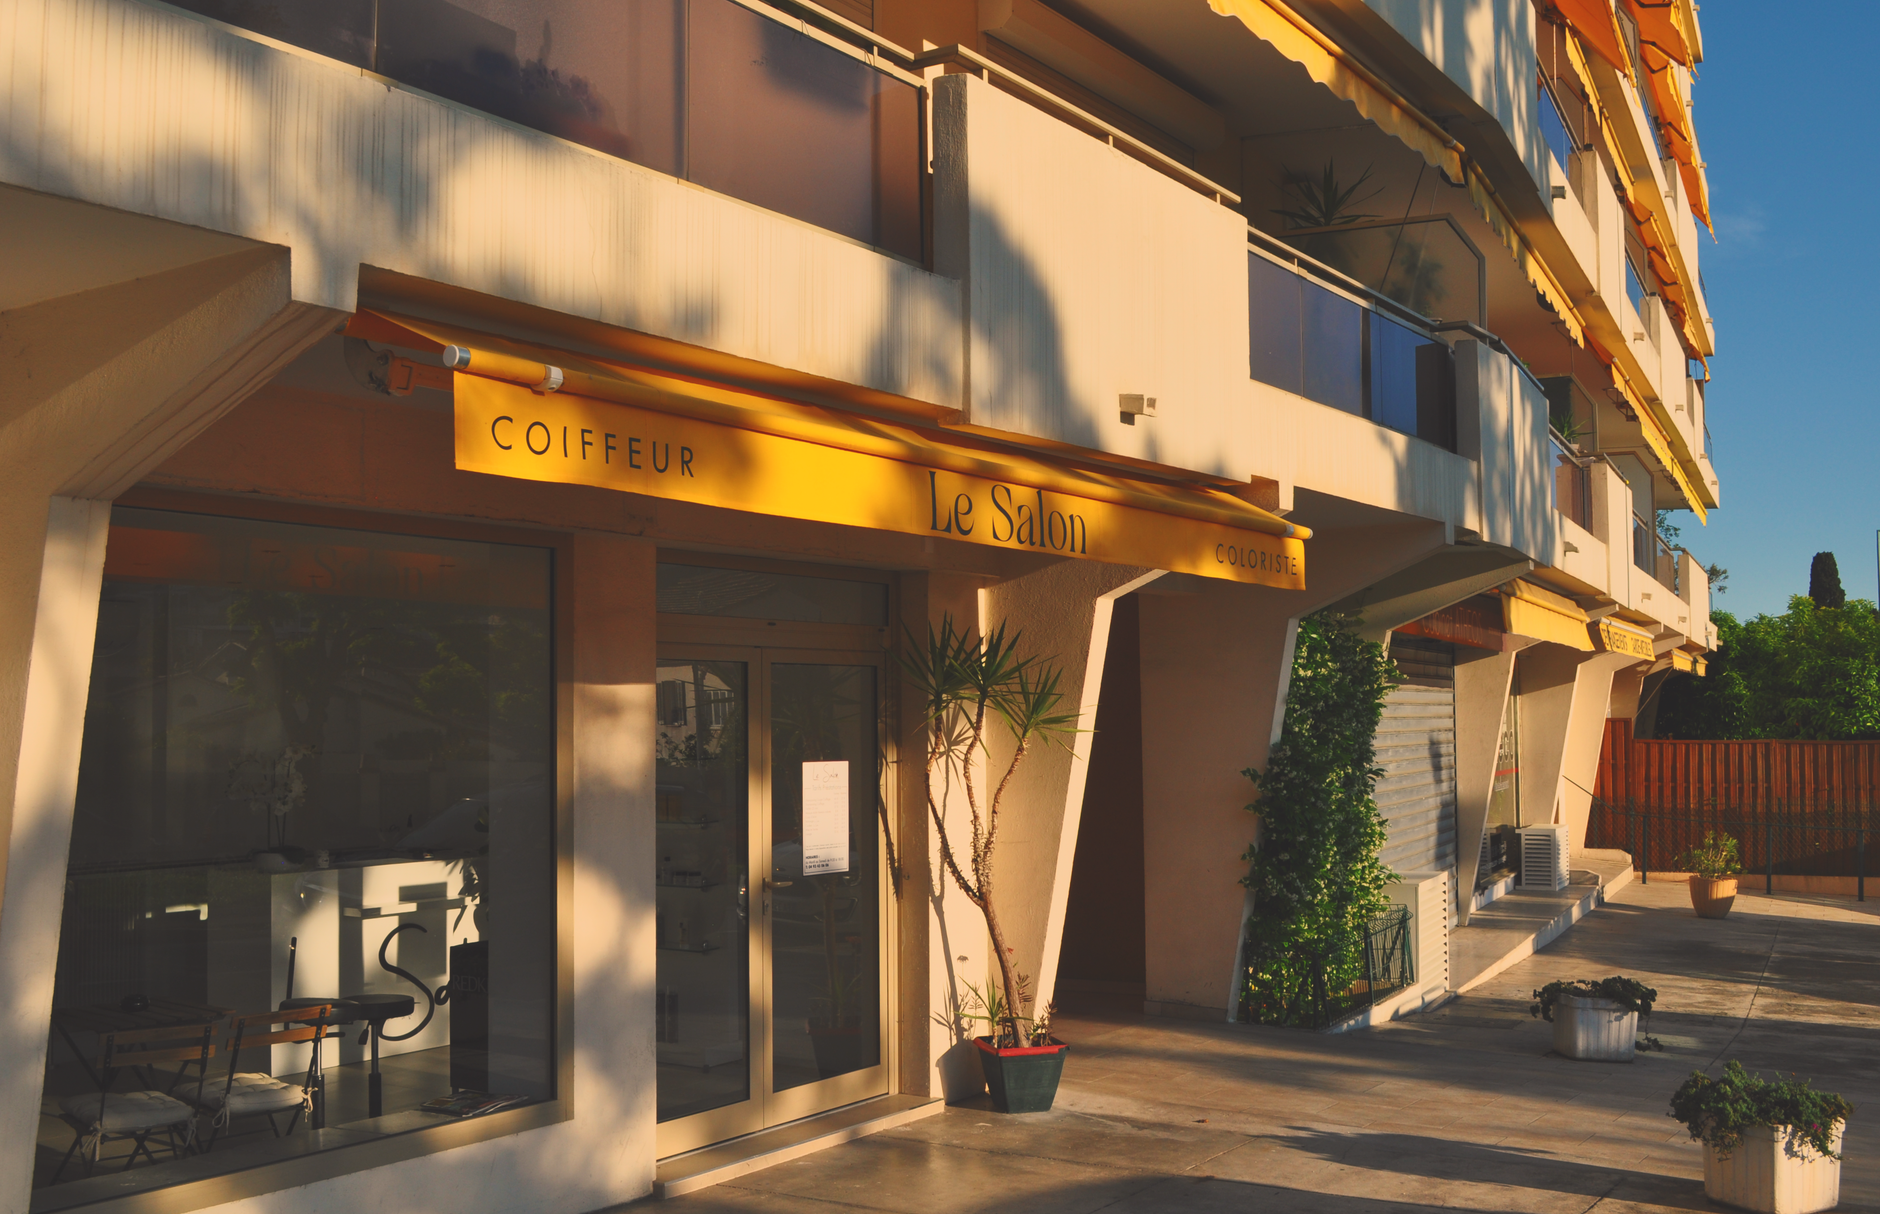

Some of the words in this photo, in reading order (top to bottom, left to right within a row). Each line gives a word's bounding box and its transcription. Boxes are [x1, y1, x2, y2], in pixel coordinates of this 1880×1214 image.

[491, 415, 694, 478] COIFFEUR
[928, 470, 974, 536] Le
[991, 484, 1087, 555] Salon
[1215, 543, 1298, 576] COLORISTE
[452, 973, 488, 993] REDK
